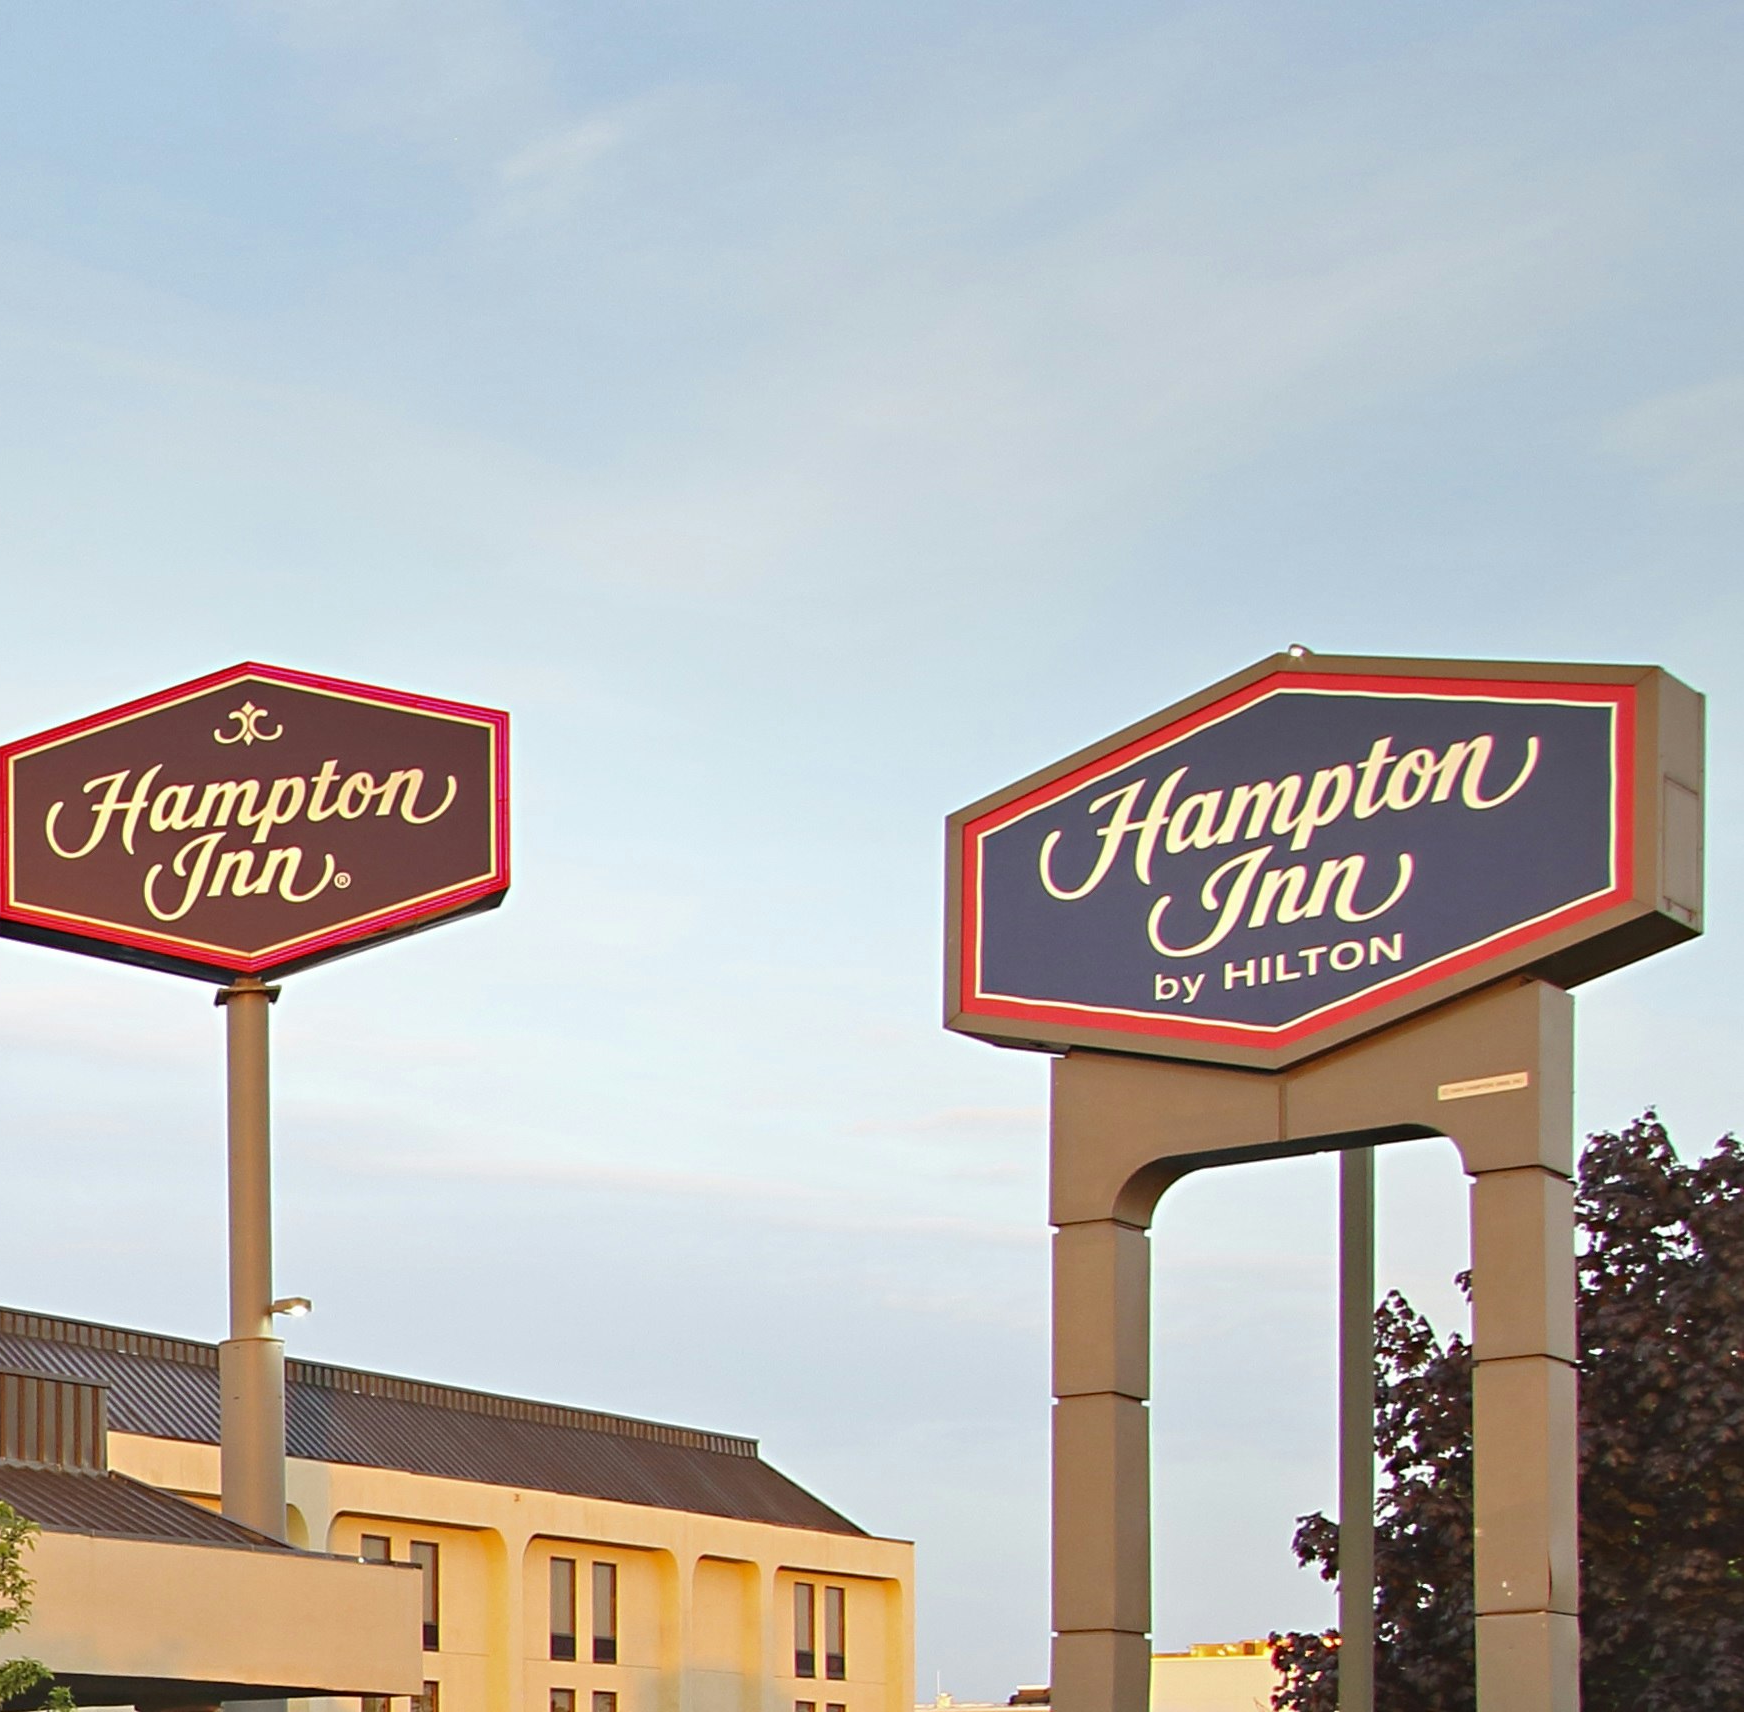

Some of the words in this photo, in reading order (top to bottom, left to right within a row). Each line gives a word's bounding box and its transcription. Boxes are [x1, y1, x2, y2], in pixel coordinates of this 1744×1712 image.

[45, 759, 458, 859] Hampton
[1039, 735, 1539, 901] Hampton
[1147, 845, 1413, 958] Inn
[1154, 973, 1205, 1004] by
[1224, 933, 1403, 990] HILTON
